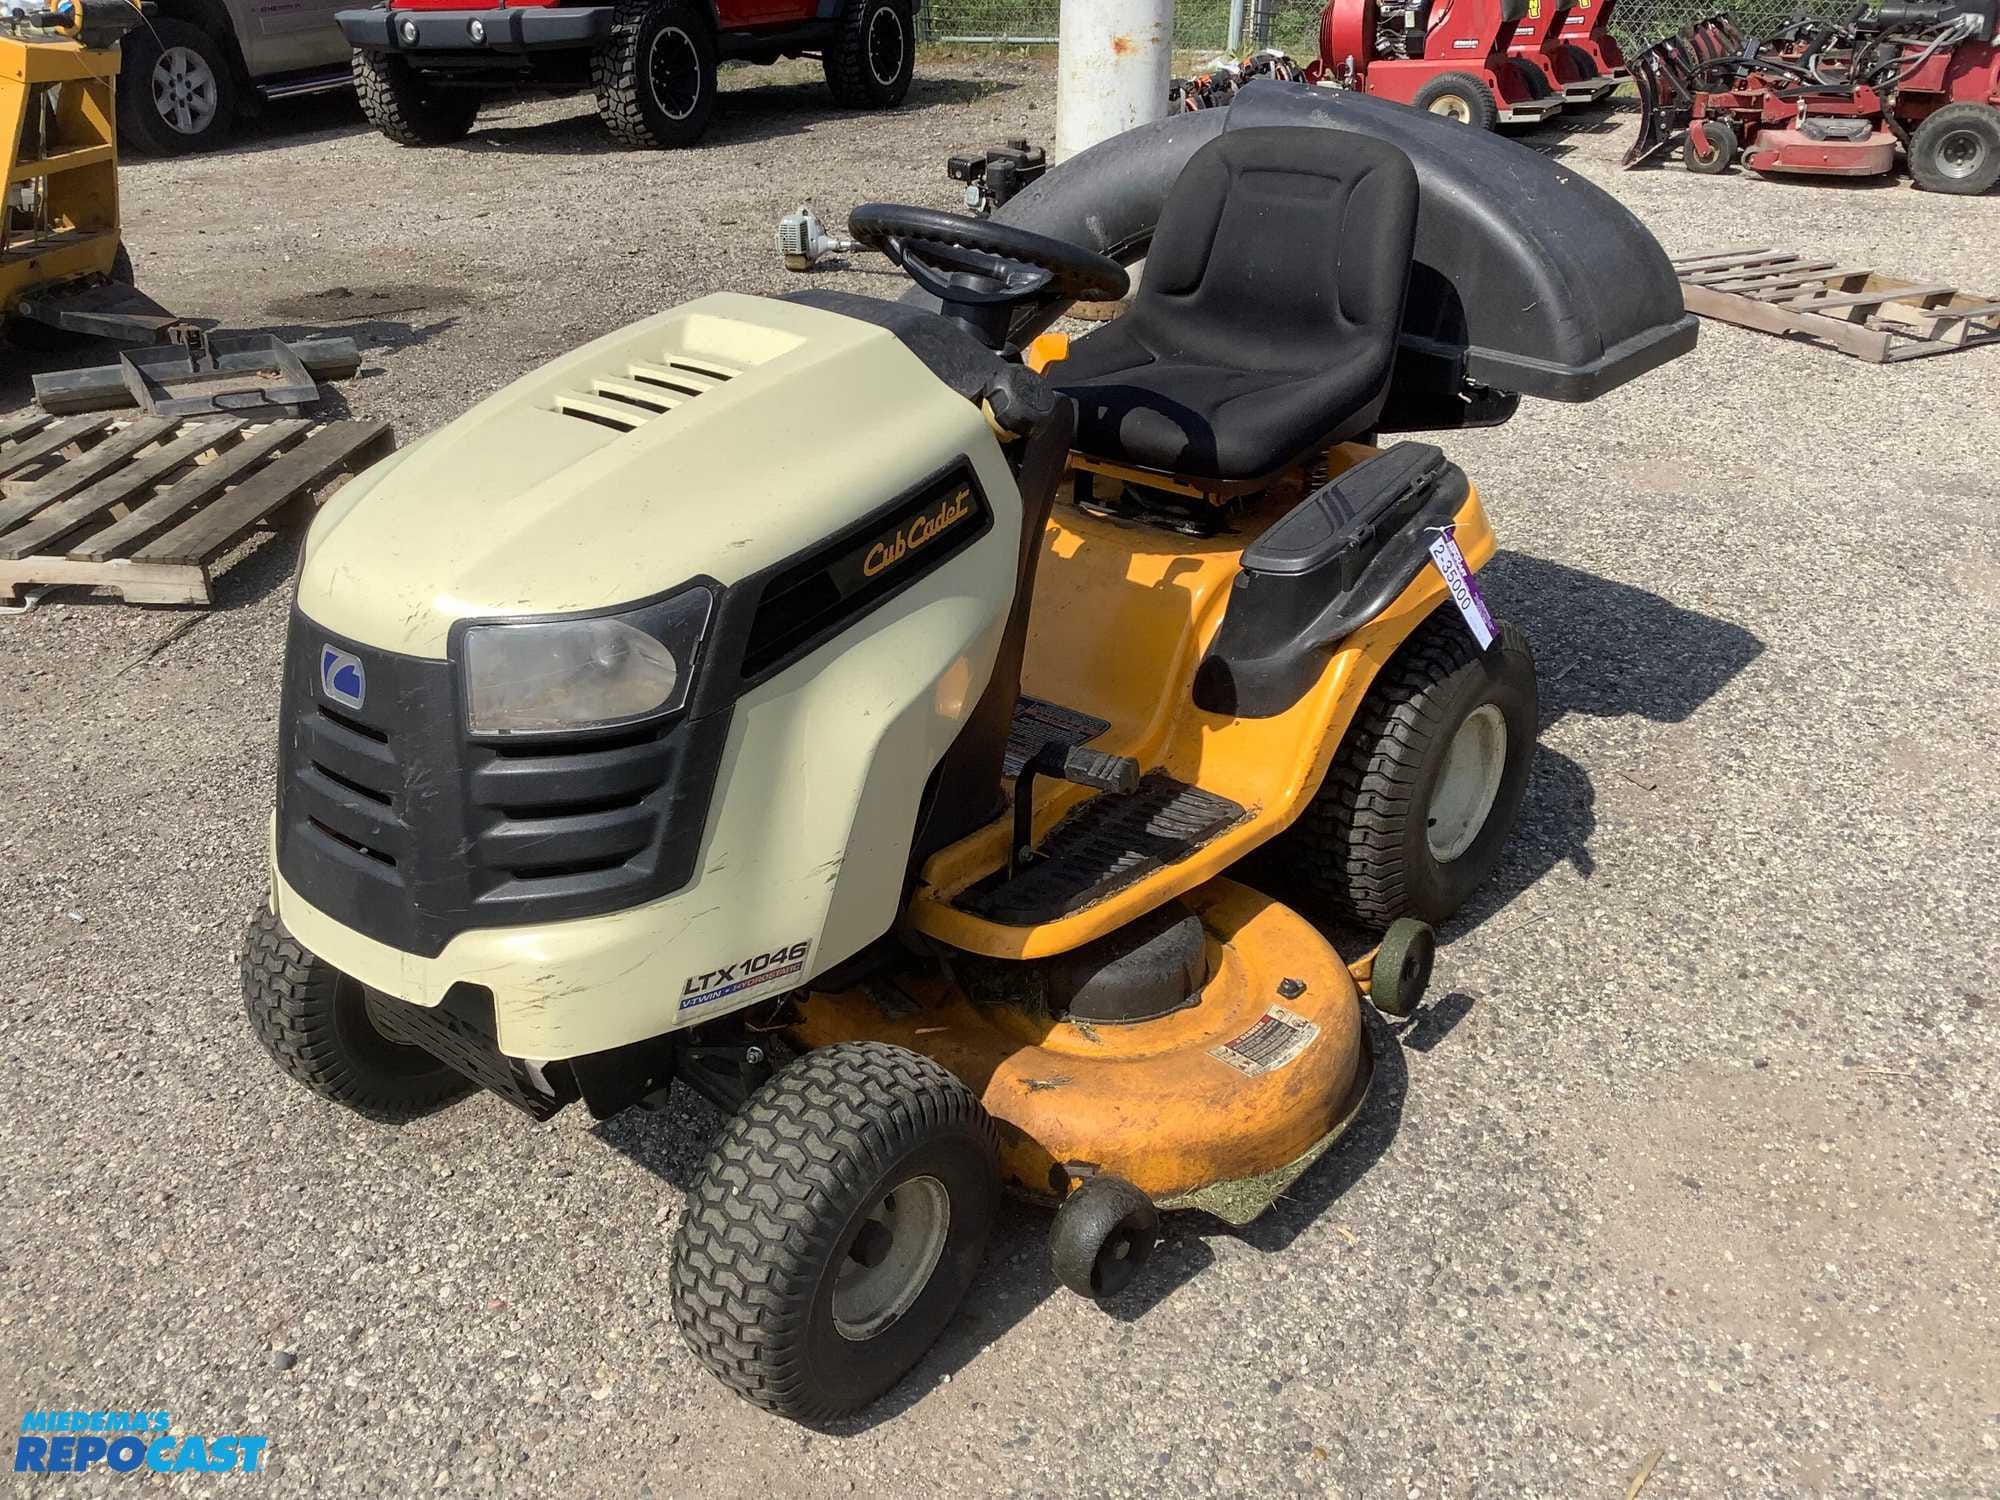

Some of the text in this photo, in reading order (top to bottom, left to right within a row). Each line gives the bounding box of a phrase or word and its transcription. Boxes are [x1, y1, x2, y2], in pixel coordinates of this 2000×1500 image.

[864, 489, 970, 577] Cub Cadet
[1433, 544, 1472, 610] 2-35000
[684, 941, 808, 995] LTX 1046
[682, 990, 722, 1008] V-TWIN
